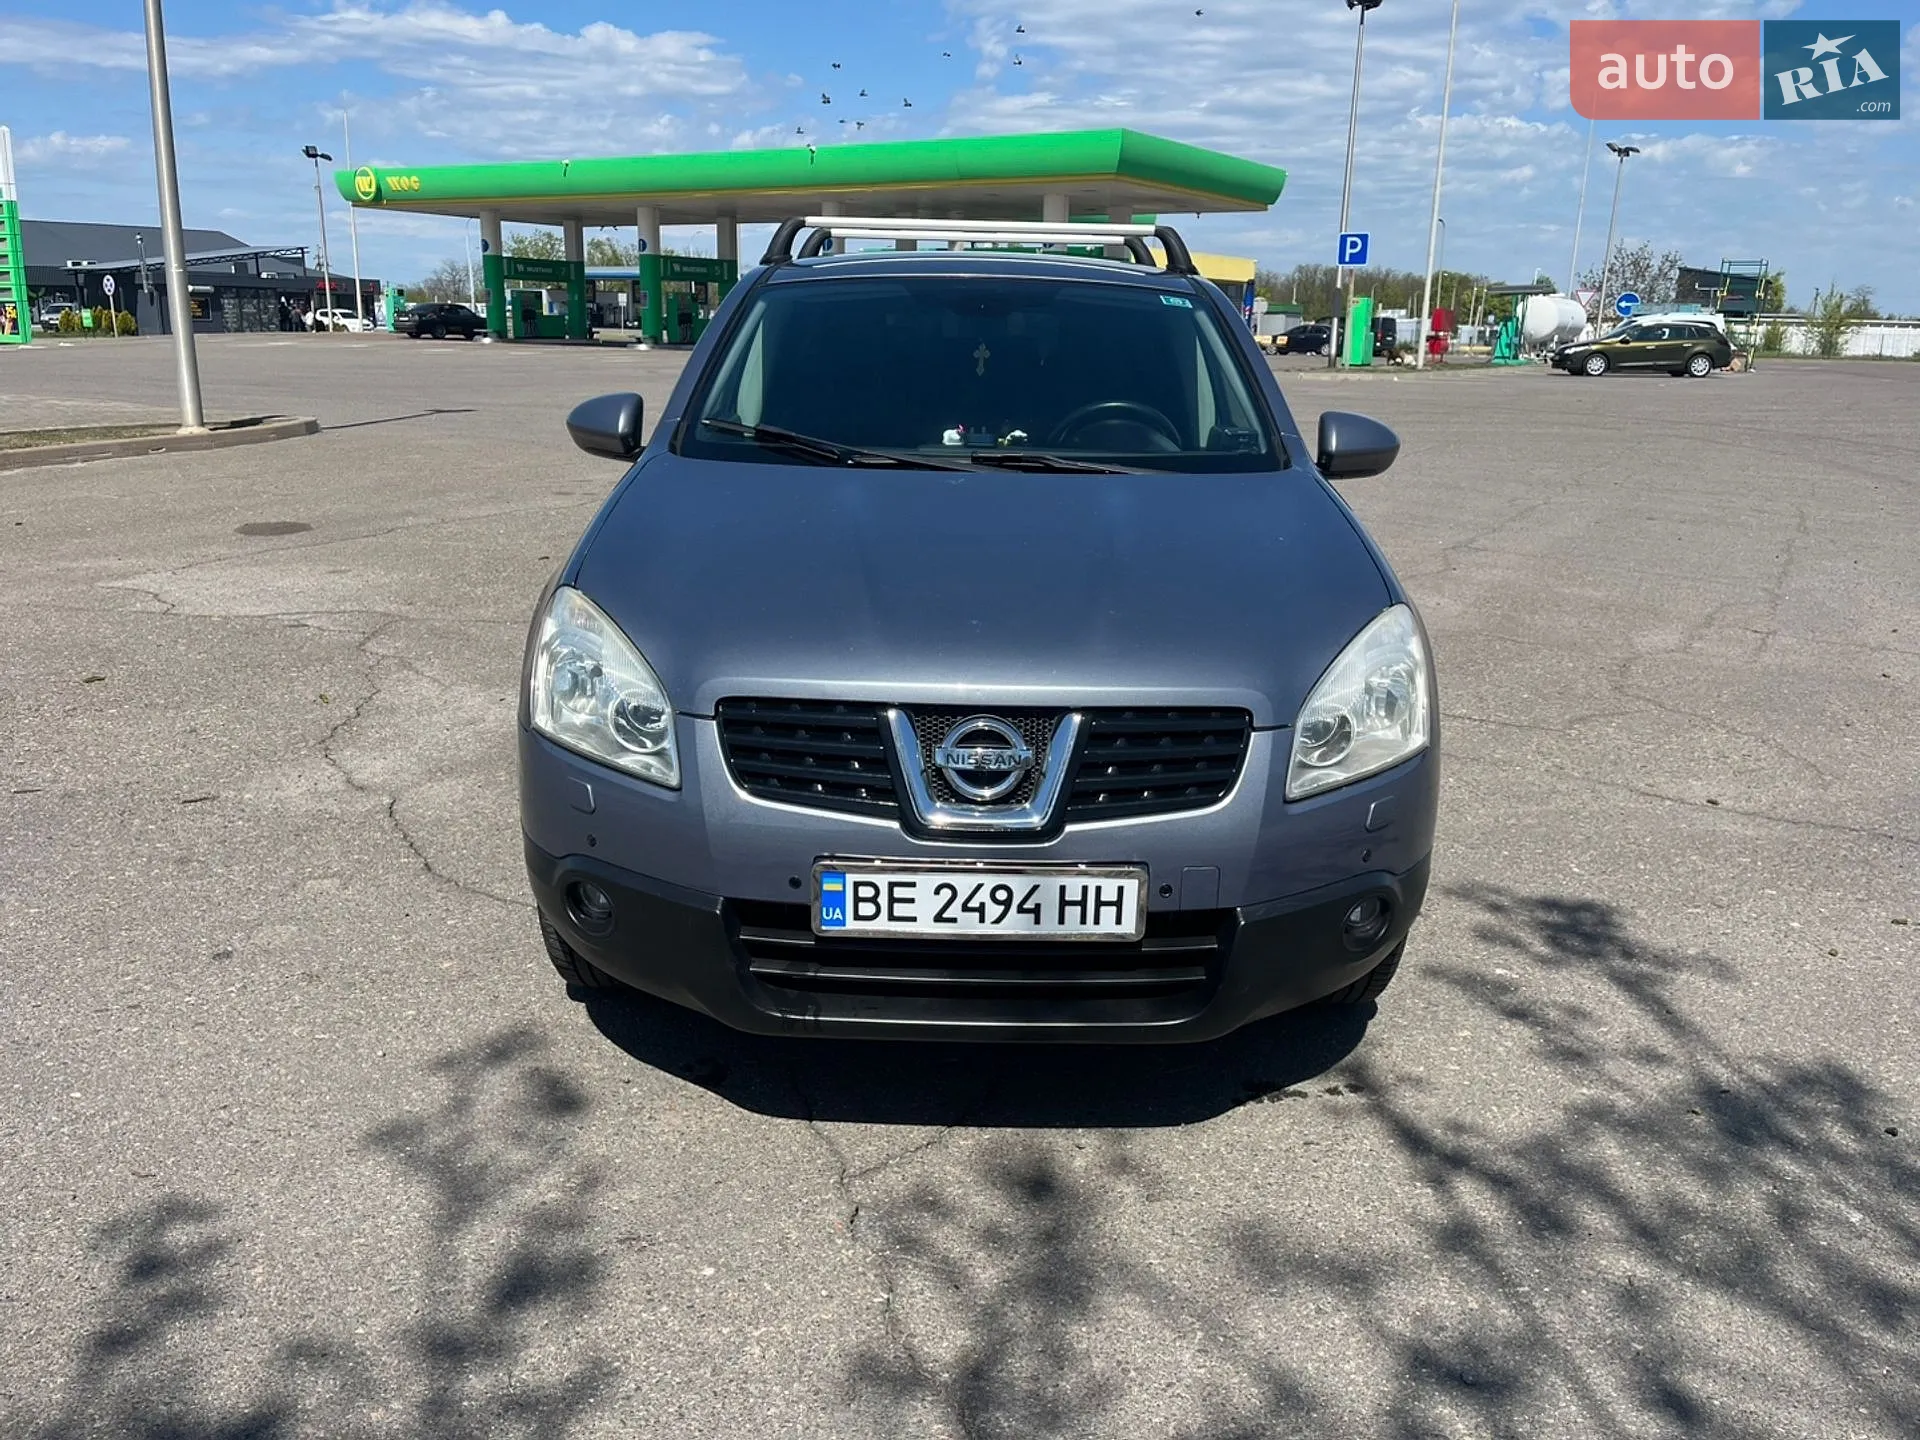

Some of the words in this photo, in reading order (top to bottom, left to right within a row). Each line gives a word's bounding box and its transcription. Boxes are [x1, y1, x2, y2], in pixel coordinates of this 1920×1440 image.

[1345, 236, 1363, 262] P
[946, 753, 1022, 766] NISSAN
[852, 880, 918, 923] BE
[932, 881, 1042, 926] 2494
[1057, 884, 1125, 926] HH
[822, 906, 843, 921] UA
